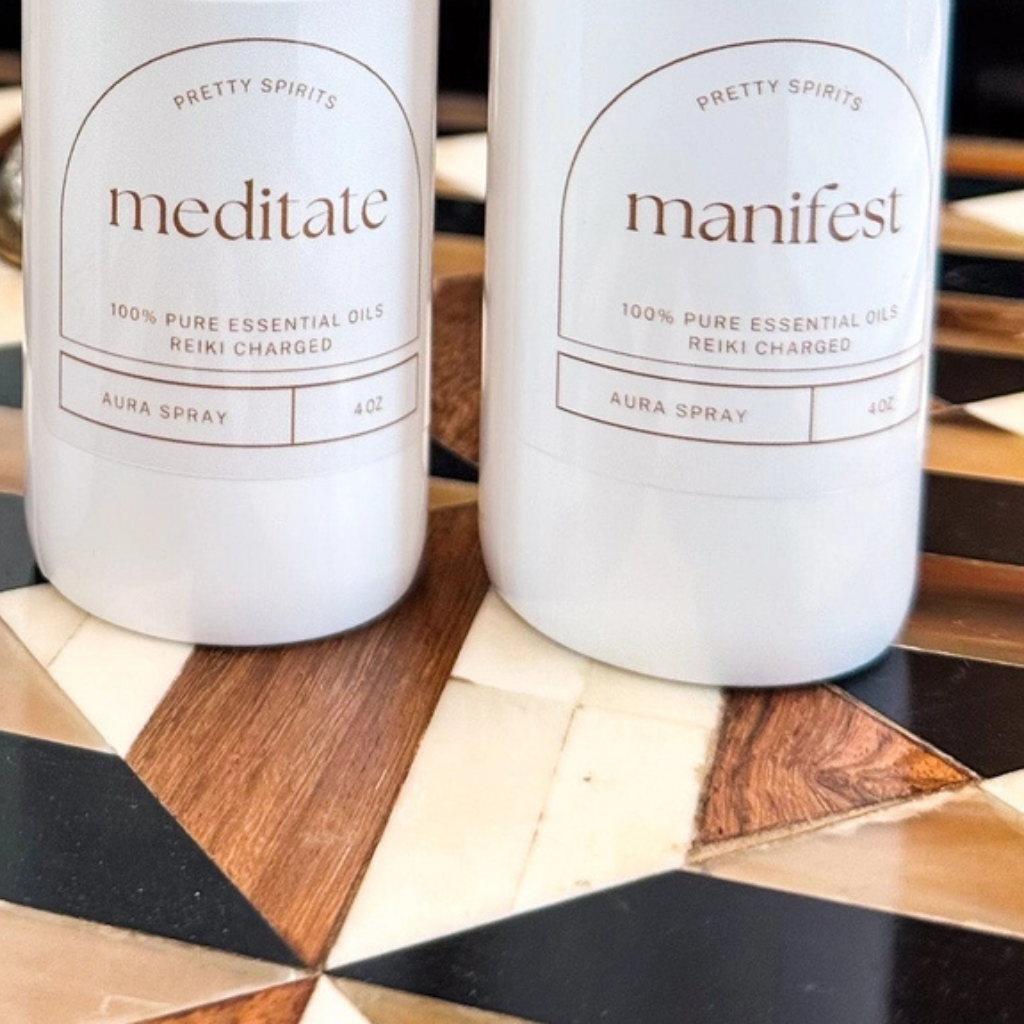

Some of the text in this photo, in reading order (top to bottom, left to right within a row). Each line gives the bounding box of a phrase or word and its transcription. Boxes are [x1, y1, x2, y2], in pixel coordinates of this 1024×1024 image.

[173, 78, 338, 110] PRETTY SPIRITS
[696, 78, 863, 112] PRETTY SPIRITS
[108, 178, 388, 242] meditate
[626, 182, 903, 245] manifest
[110, 302, 384, 332] 100% PURE ESSENTIAL OILS
[622, 302, 899, 332] 100% PURE ESSENTIAL OILS
[170, 336, 333, 356] REIKI CHARGED
[688, 335, 851, 356] REIKI CHARGED
[101, 391, 229, 425] AURA SPRAY
[609, 390, 748, 424] AURA SPRAY
